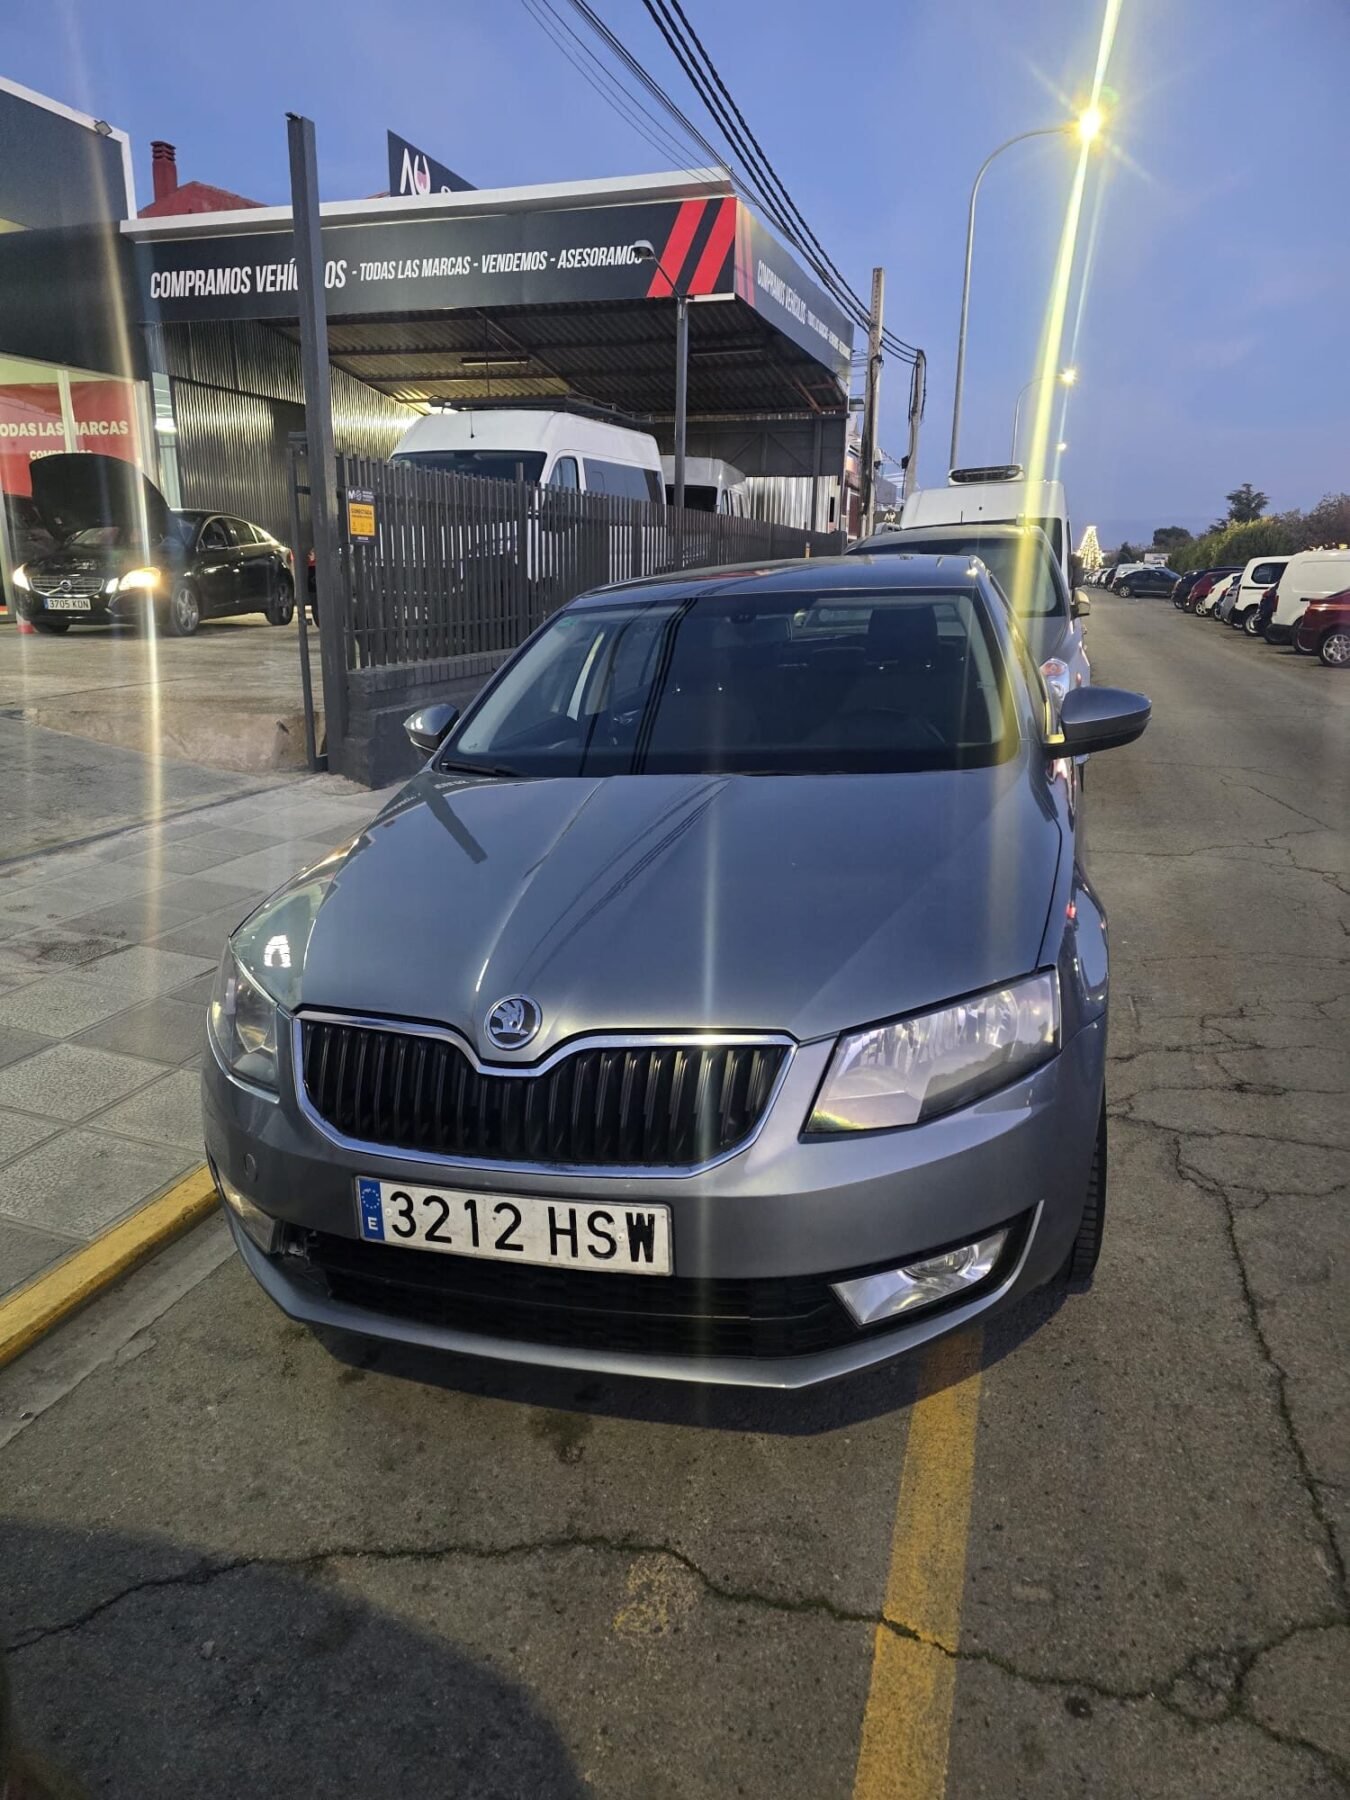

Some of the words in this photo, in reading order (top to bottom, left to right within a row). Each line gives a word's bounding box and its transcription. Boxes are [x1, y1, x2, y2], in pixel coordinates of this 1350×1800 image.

[150, 266, 252, 299] COMPRAMOS
[255, 257, 348, 293] VEHÍCOS
[360, 261, 396, 281] TODAS
[398, 259, 420, 279] LAS
[421, 256, 471, 278] MARCAS
[481, 251, 548, 274] VENDEMOS
[0, 422, 37, 437] ODAS
[39, 422, 64, 436] LAS
[368, 1216, 379, 1231] E
[390, 1191, 524, 1252] 3212
[547, 1206, 656, 1263] HSW
